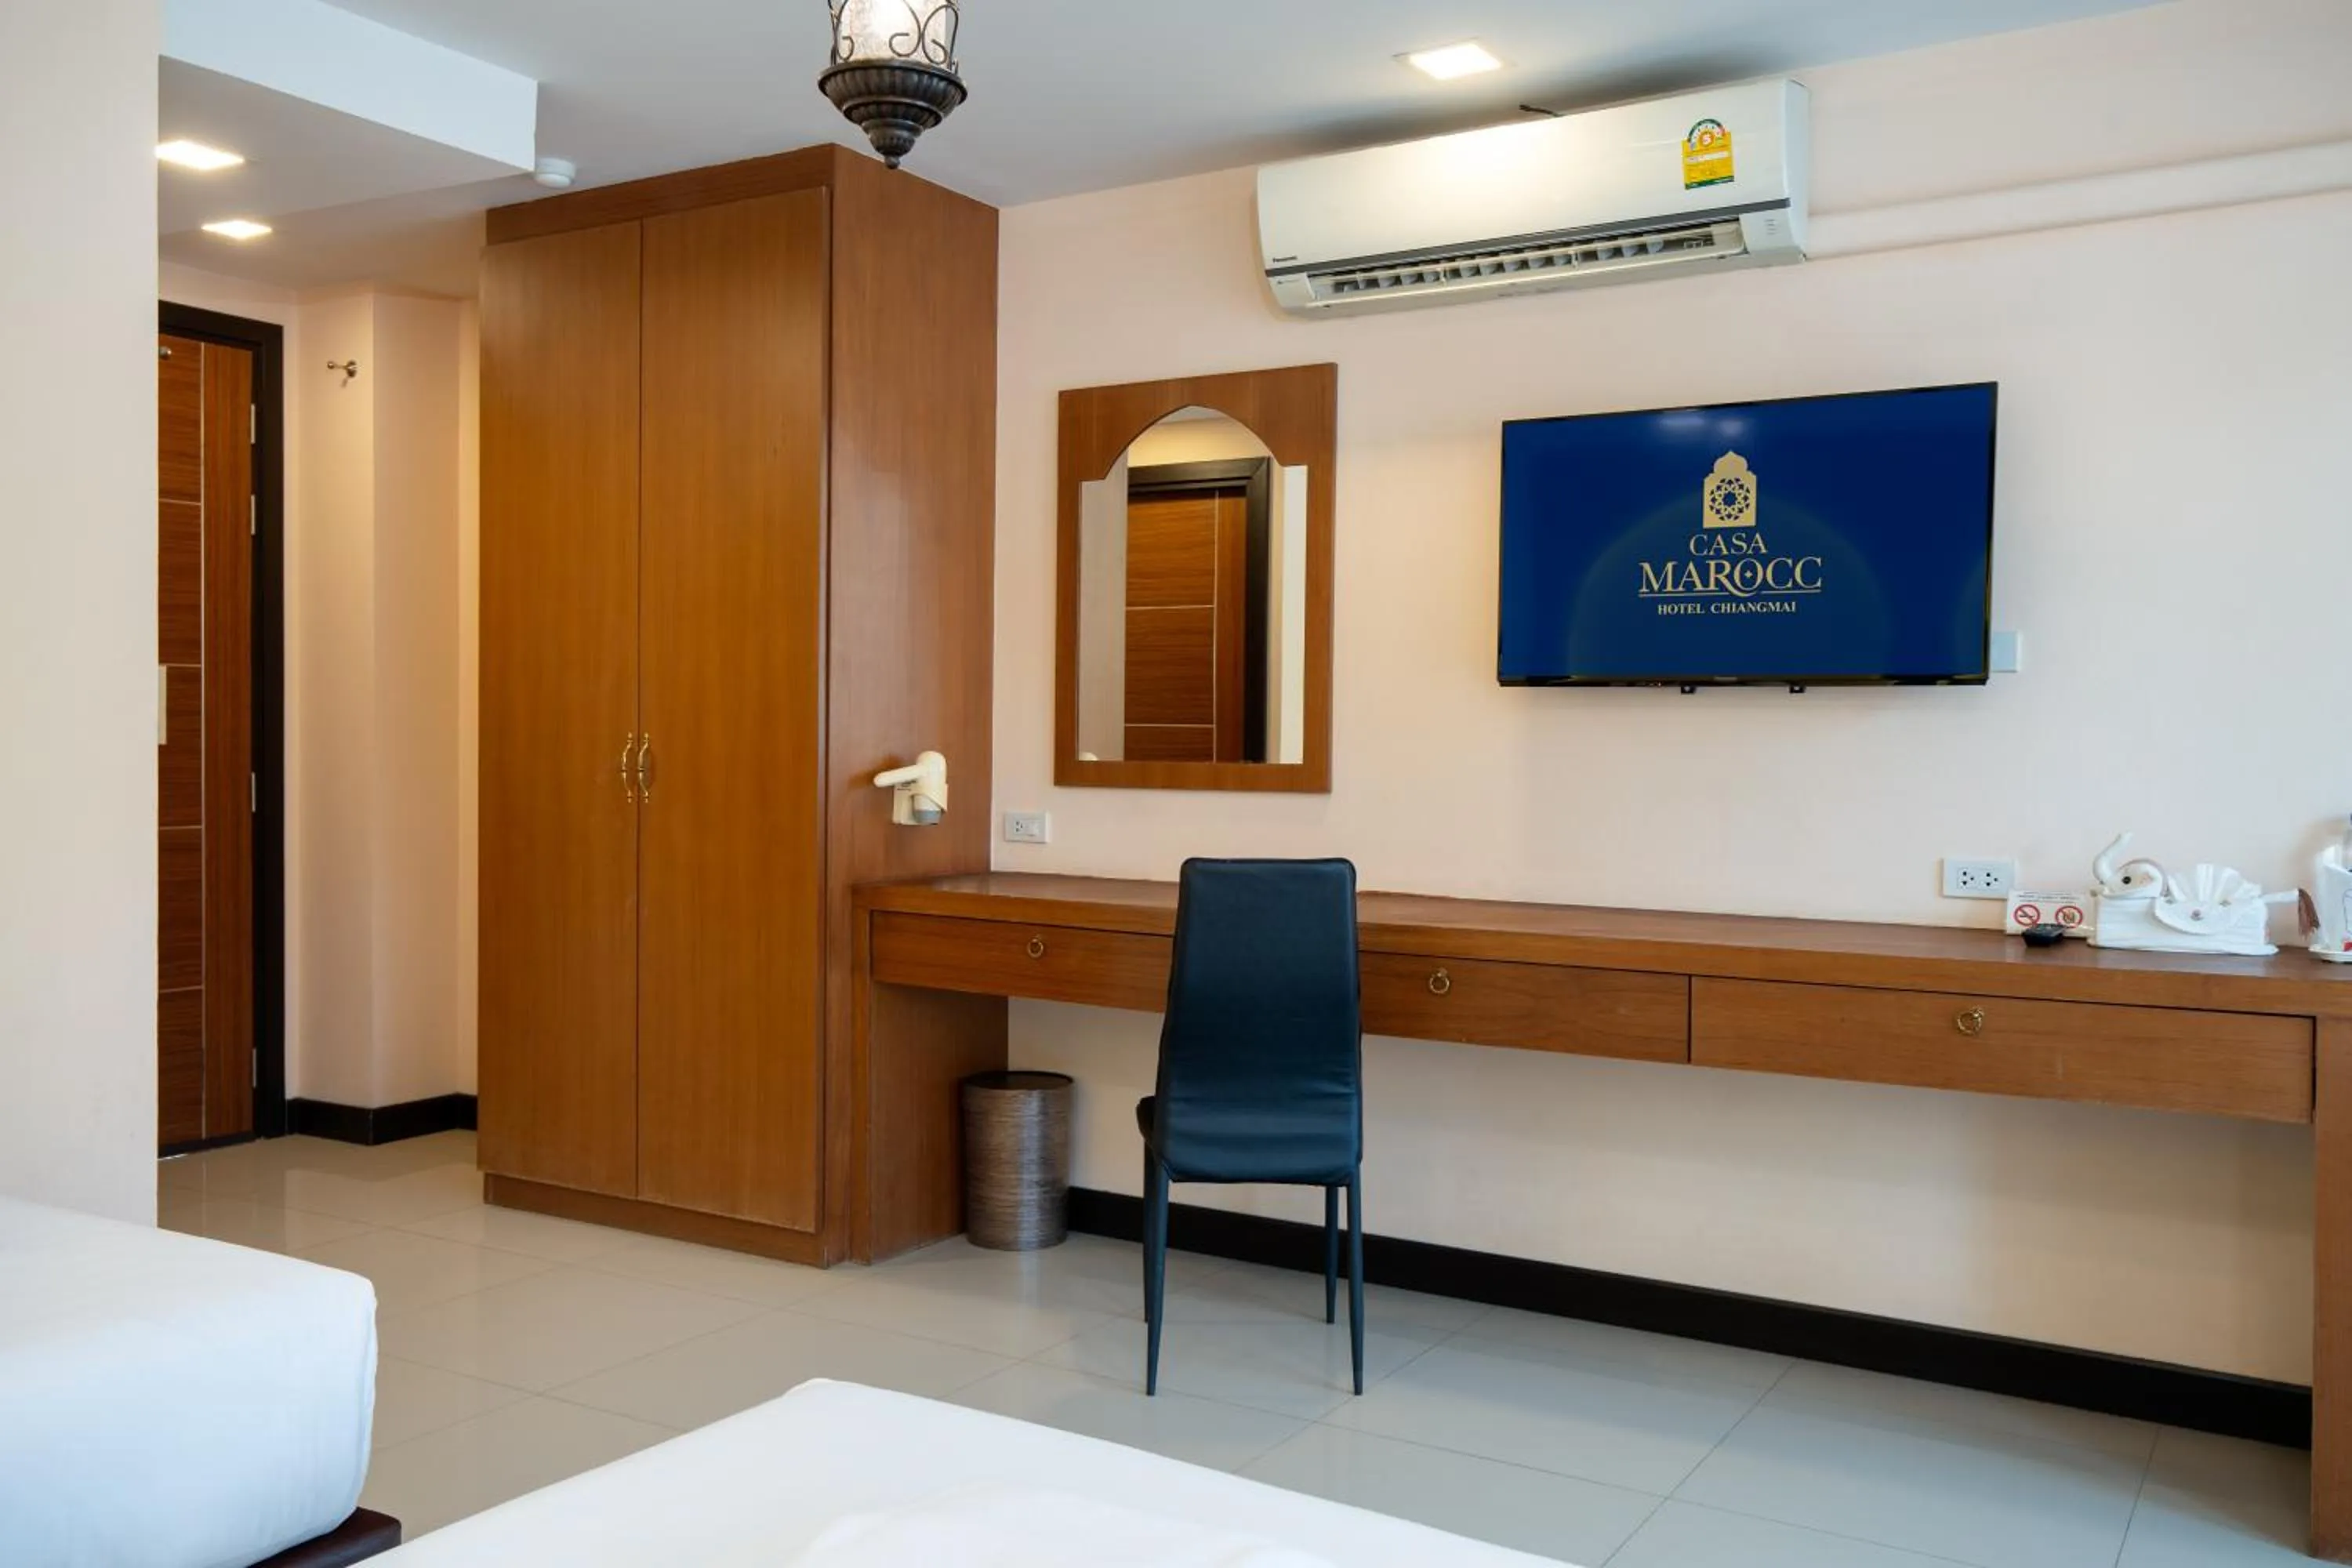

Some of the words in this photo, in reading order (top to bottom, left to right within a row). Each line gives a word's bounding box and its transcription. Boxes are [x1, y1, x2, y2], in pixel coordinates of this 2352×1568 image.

[1690, 532, 1768, 556] CASA
[1639, 557, 1821, 596] MAROCC
[1657, 602, 1705, 615] HOTEL
[1711, 601, 1796, 614] CHIANGMAI
